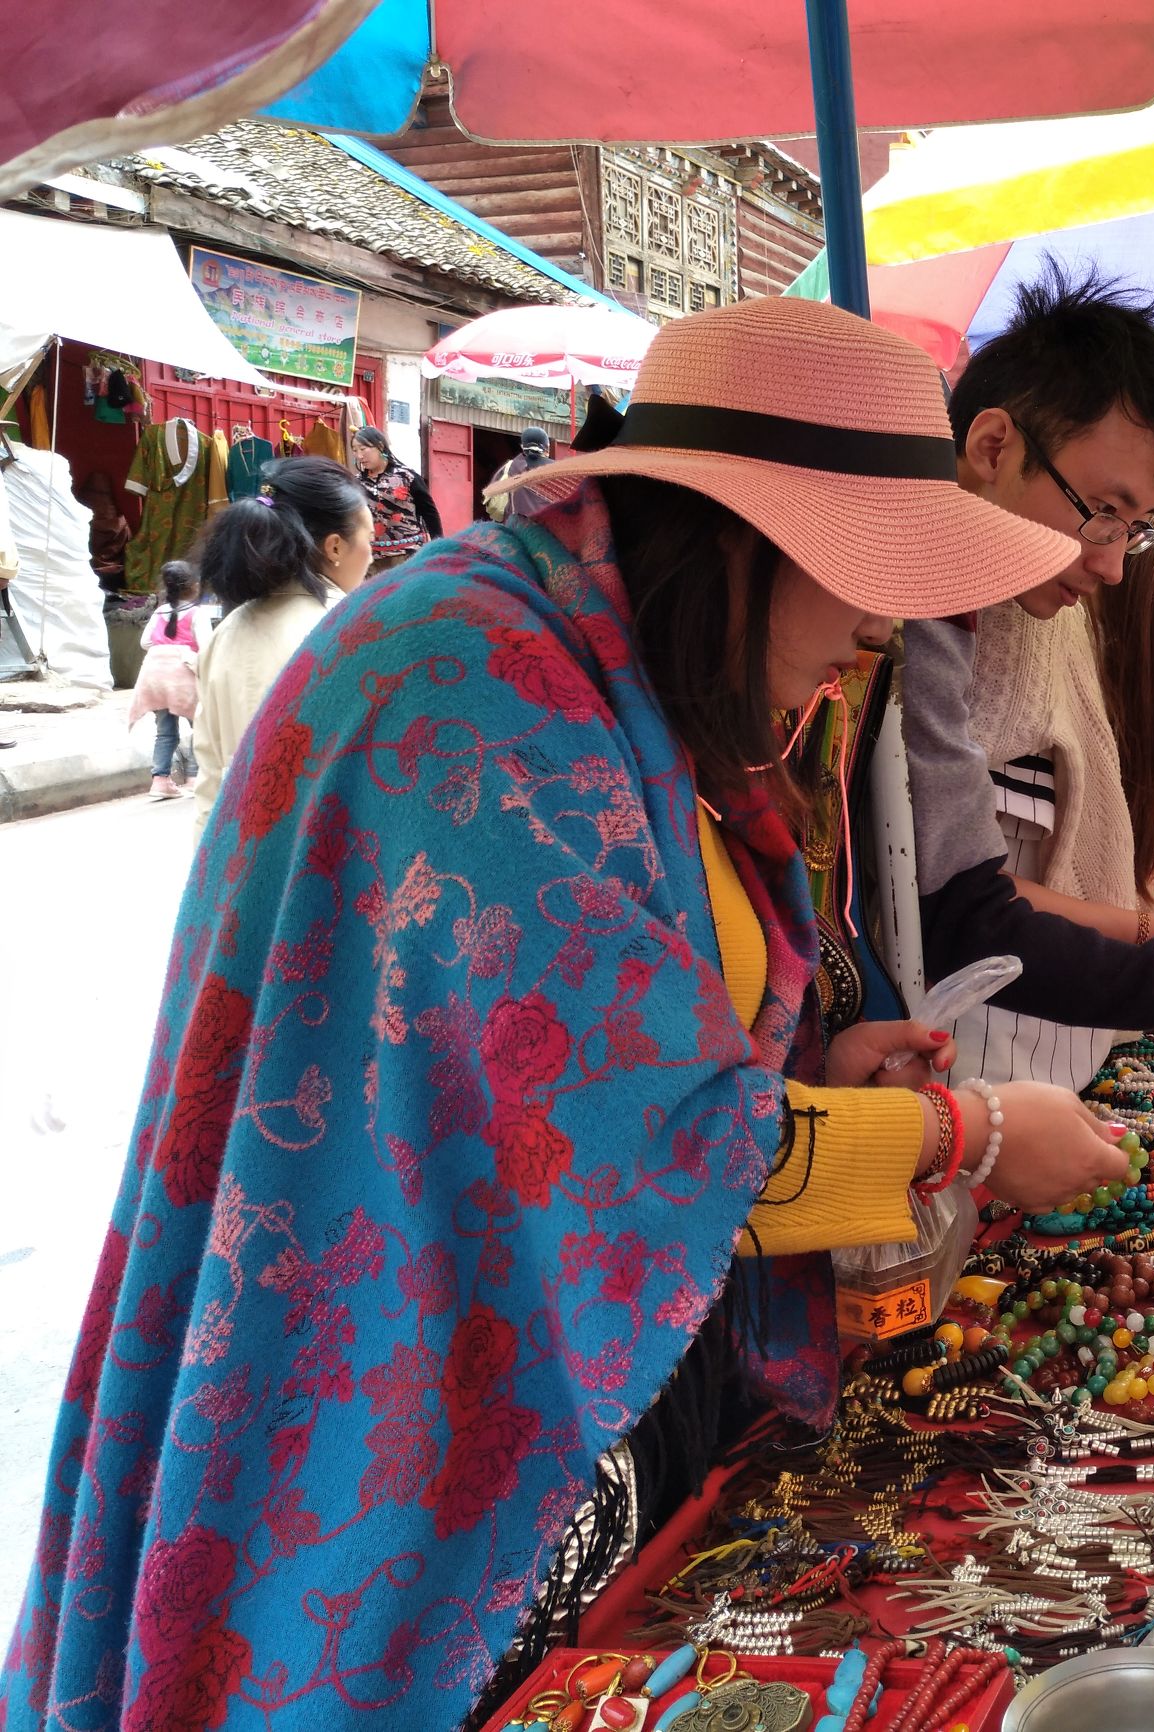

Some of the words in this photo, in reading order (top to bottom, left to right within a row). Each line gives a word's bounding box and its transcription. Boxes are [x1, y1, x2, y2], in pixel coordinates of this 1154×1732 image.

[231, 311, 275, 329] National
[279, 325, 314, 338] general
[319, 331, 342, 344] store
[491, 351, 535, 367] 可口可乐
